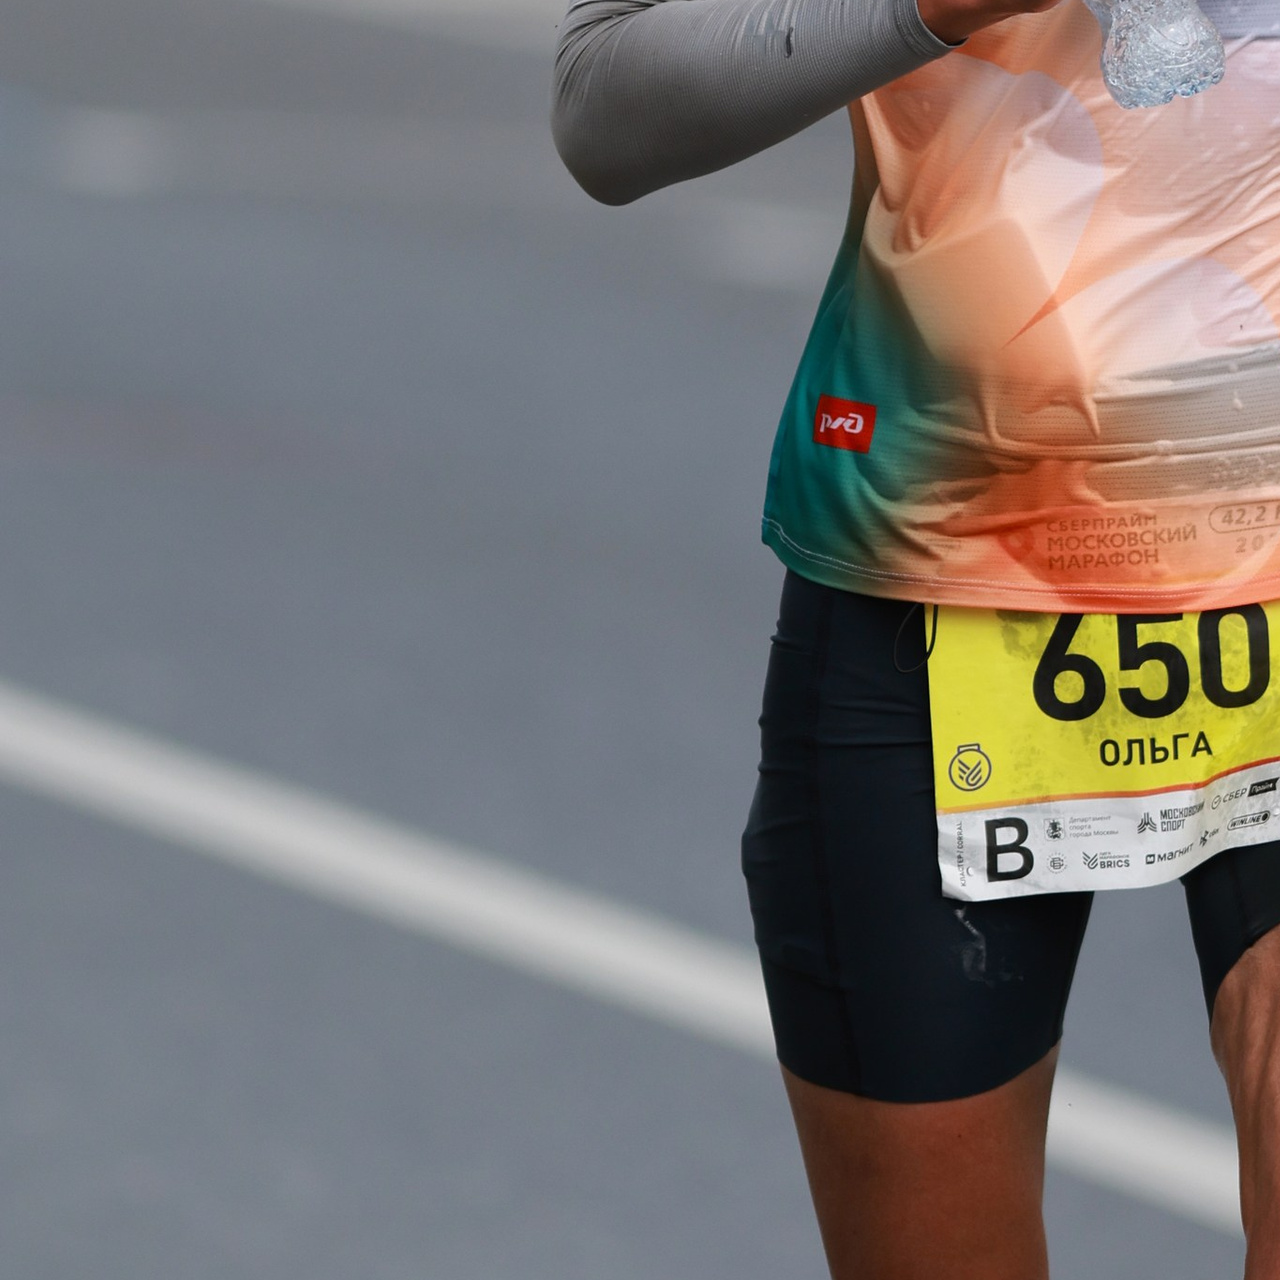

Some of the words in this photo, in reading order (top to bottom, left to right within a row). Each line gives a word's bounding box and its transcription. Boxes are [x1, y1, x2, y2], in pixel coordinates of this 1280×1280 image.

[1046, 523, 1198, 552] МОСКОВСКИЙ
[1047, 549, 1160, 571] МАРАФОН
[1032, 604, 1271, 721] 650
[1099, 730, 1213, 767] ОЛЬГА
[1222, 787, 1247, 803] СБЕР
[1160, 818, 1186, 832] СПОРТ
[1100, 859, 1130, 869] BRICS
